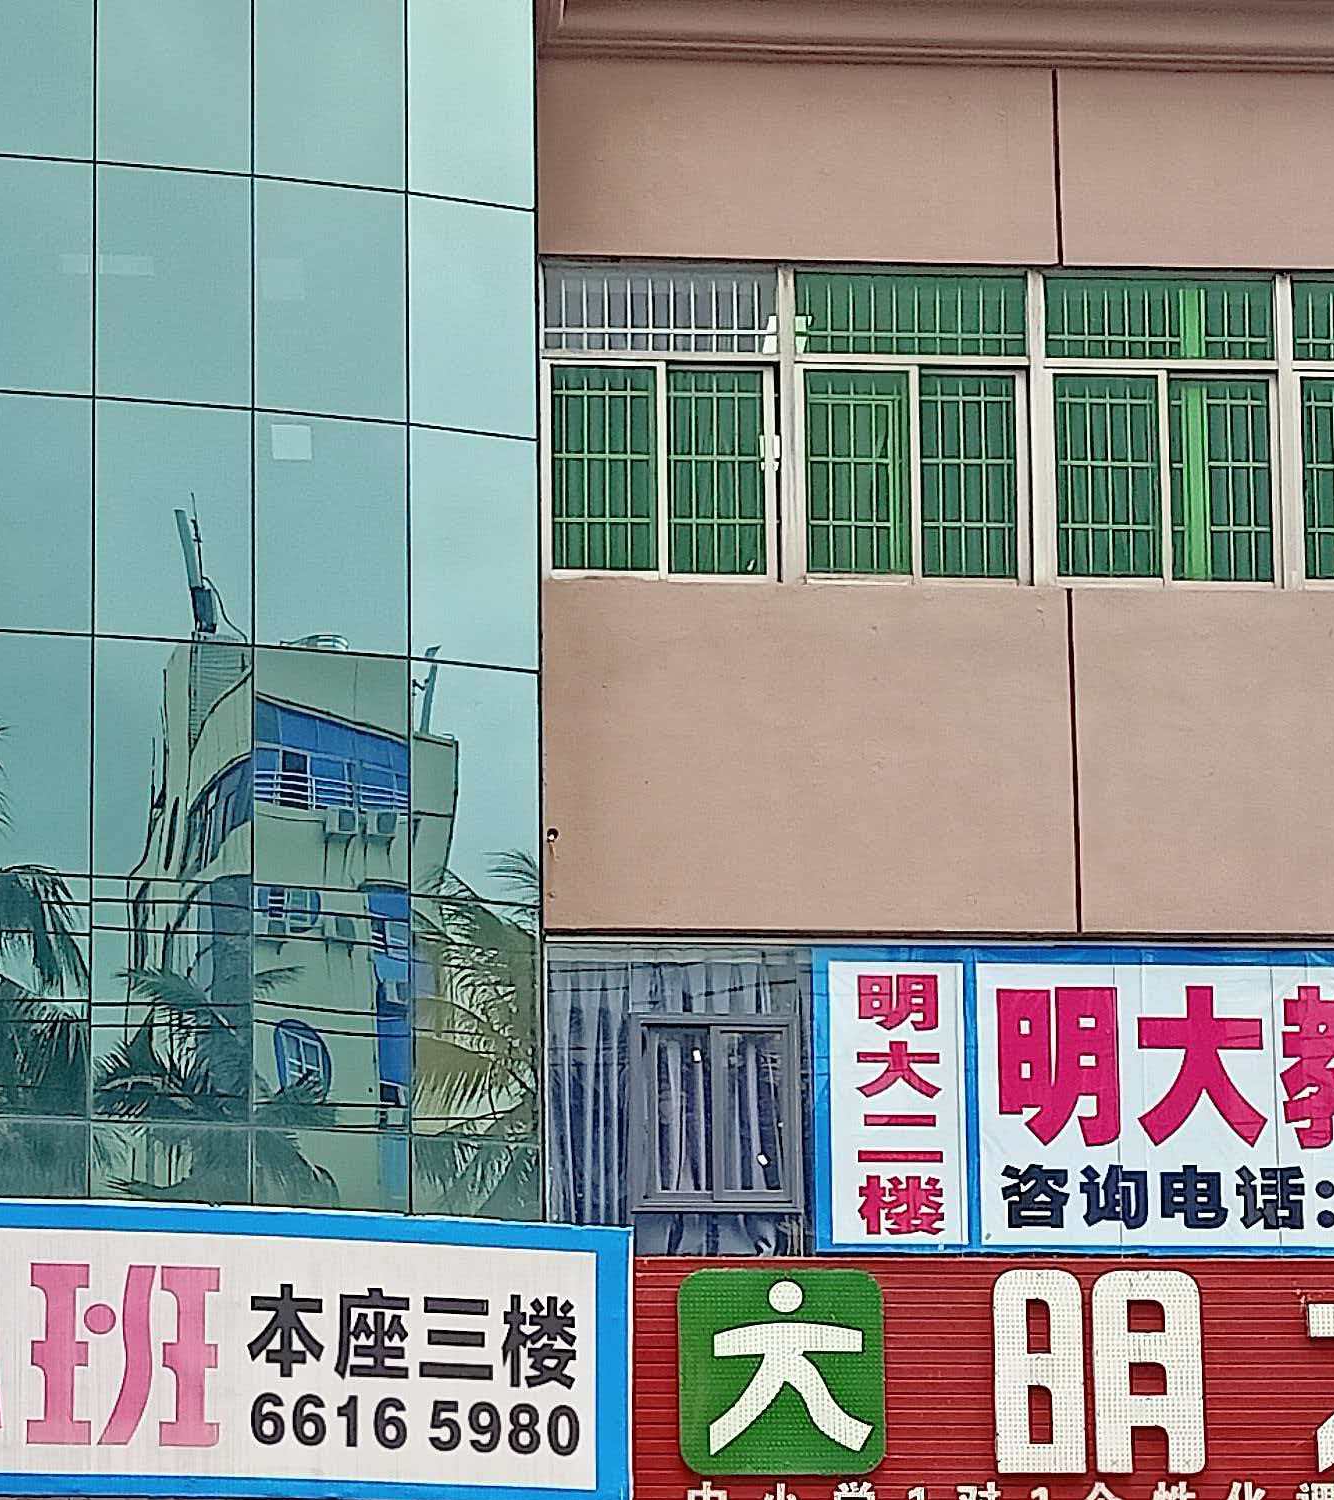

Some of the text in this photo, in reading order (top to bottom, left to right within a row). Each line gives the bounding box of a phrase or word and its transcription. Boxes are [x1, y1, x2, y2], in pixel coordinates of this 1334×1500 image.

[856, 974, 945, 1236] 明大二楼
[248, 1283, 579, 1390] 本座三楼
[250, 1393, 581, 1457] 6616 5980
